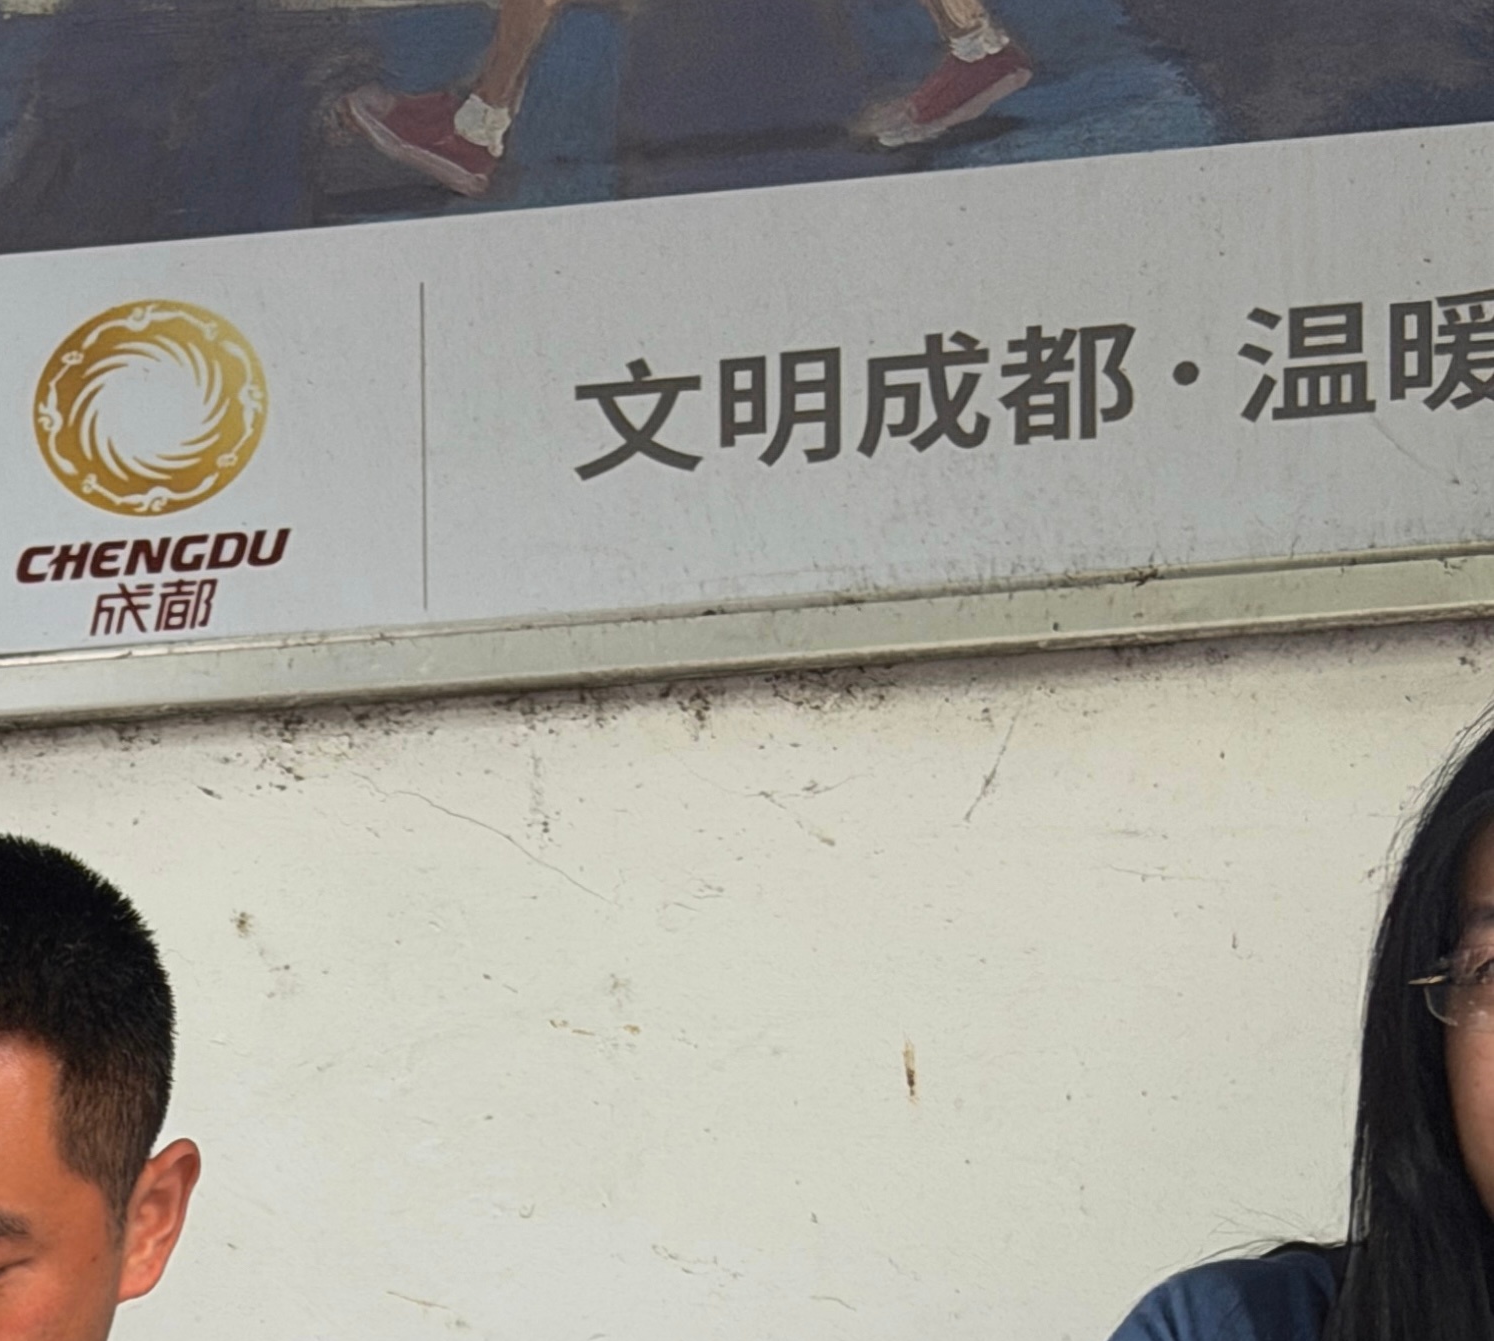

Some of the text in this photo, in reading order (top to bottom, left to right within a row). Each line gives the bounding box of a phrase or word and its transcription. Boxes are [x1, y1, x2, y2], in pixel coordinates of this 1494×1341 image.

[575, 289, 1494, 480] 文明成都·温暖
[17, 528, 291, 583] CHENGDU
[91, 579, 217, 635] 成都
